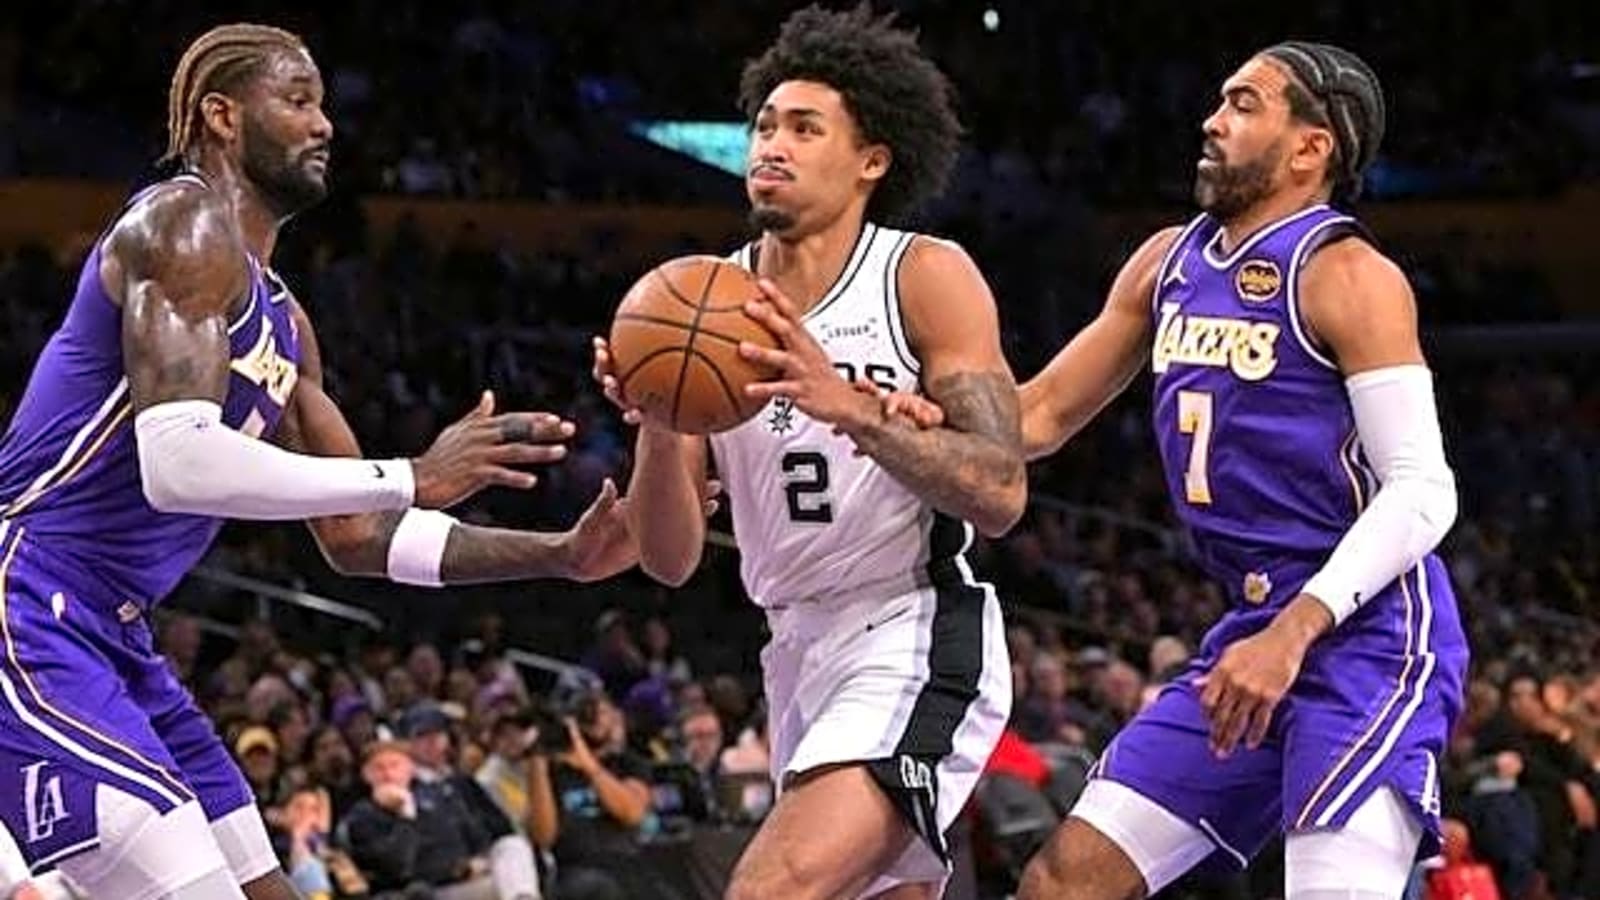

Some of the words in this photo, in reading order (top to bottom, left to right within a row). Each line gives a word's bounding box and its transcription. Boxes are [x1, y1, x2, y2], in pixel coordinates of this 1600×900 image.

[1152, 301, 1281, 381] LAKERS
[782, 452, 833, 523] 2
[1178, 390, 1213, 504] 7
[20, 760, 71, 843] LA
